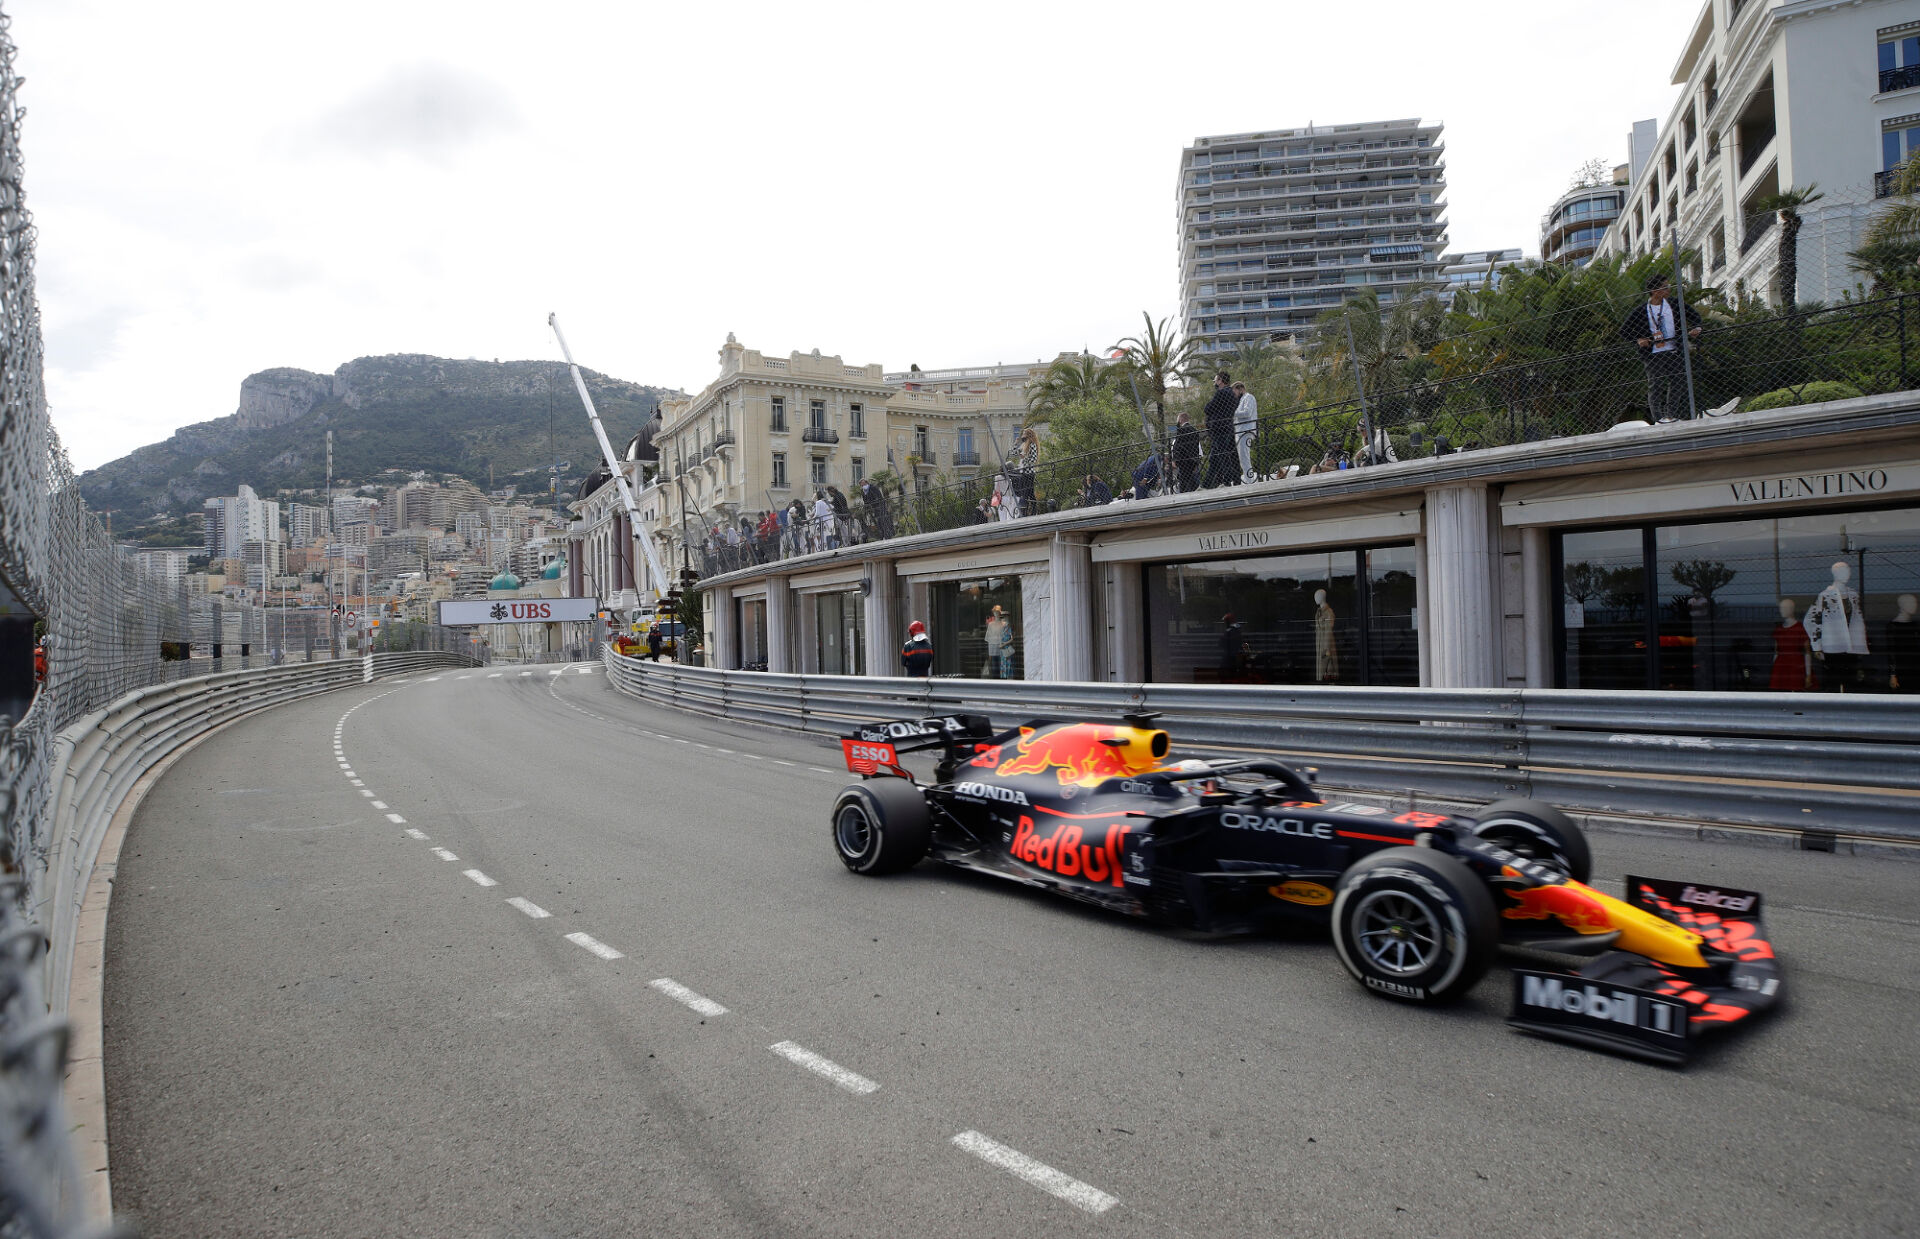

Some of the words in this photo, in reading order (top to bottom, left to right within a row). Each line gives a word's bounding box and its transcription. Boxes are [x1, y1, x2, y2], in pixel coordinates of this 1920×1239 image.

[1730, 469, 1888, 502] VALENTINO
[1199, 531, 1268, 550] VALENTINO
[511, 603, 551, 618] UBS
[851, 745, 890, 762] ESSO
[970, 743, 1003, 768] 33
[955, 781, 1030, 806] HONDA
[1220, 812, 1333, 840] ORACLE
[1523, 975, 1638, 1026] Mobil
[1651, 1003, 1672, 1032] 1
